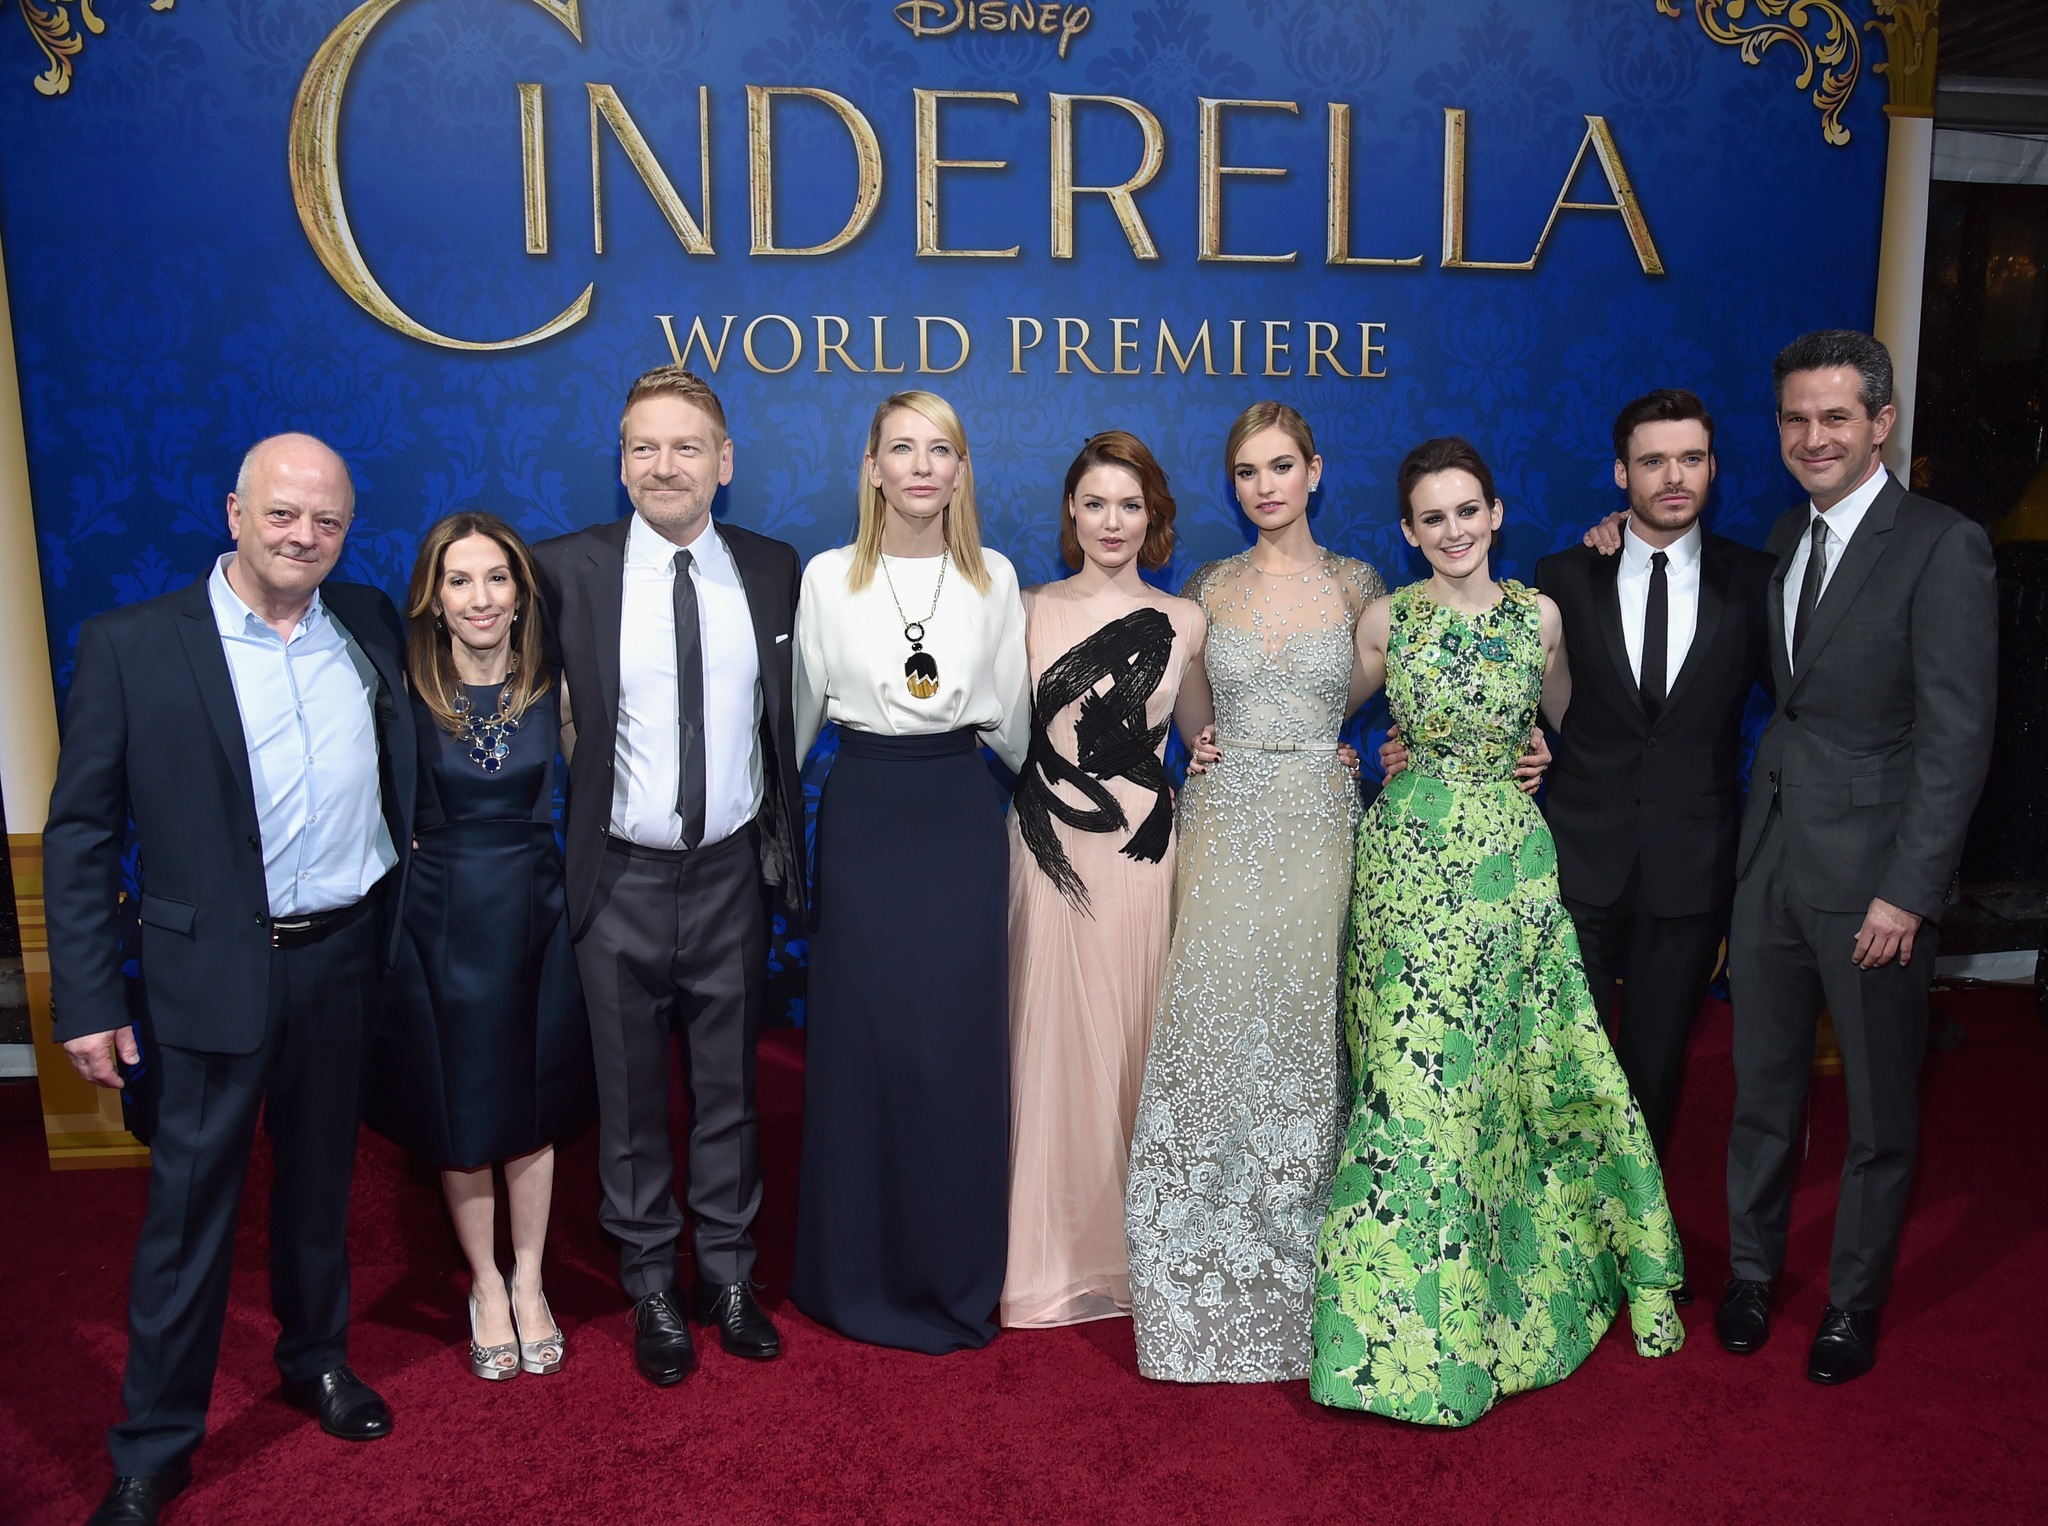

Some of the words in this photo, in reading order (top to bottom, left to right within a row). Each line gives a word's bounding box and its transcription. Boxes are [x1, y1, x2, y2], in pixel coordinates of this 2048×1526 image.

[288, 0, 1665, 350] CINDERELLA
[654, 314, 970, 374] WORLD
[1006, 316, 1388, 379] PREMIERE
